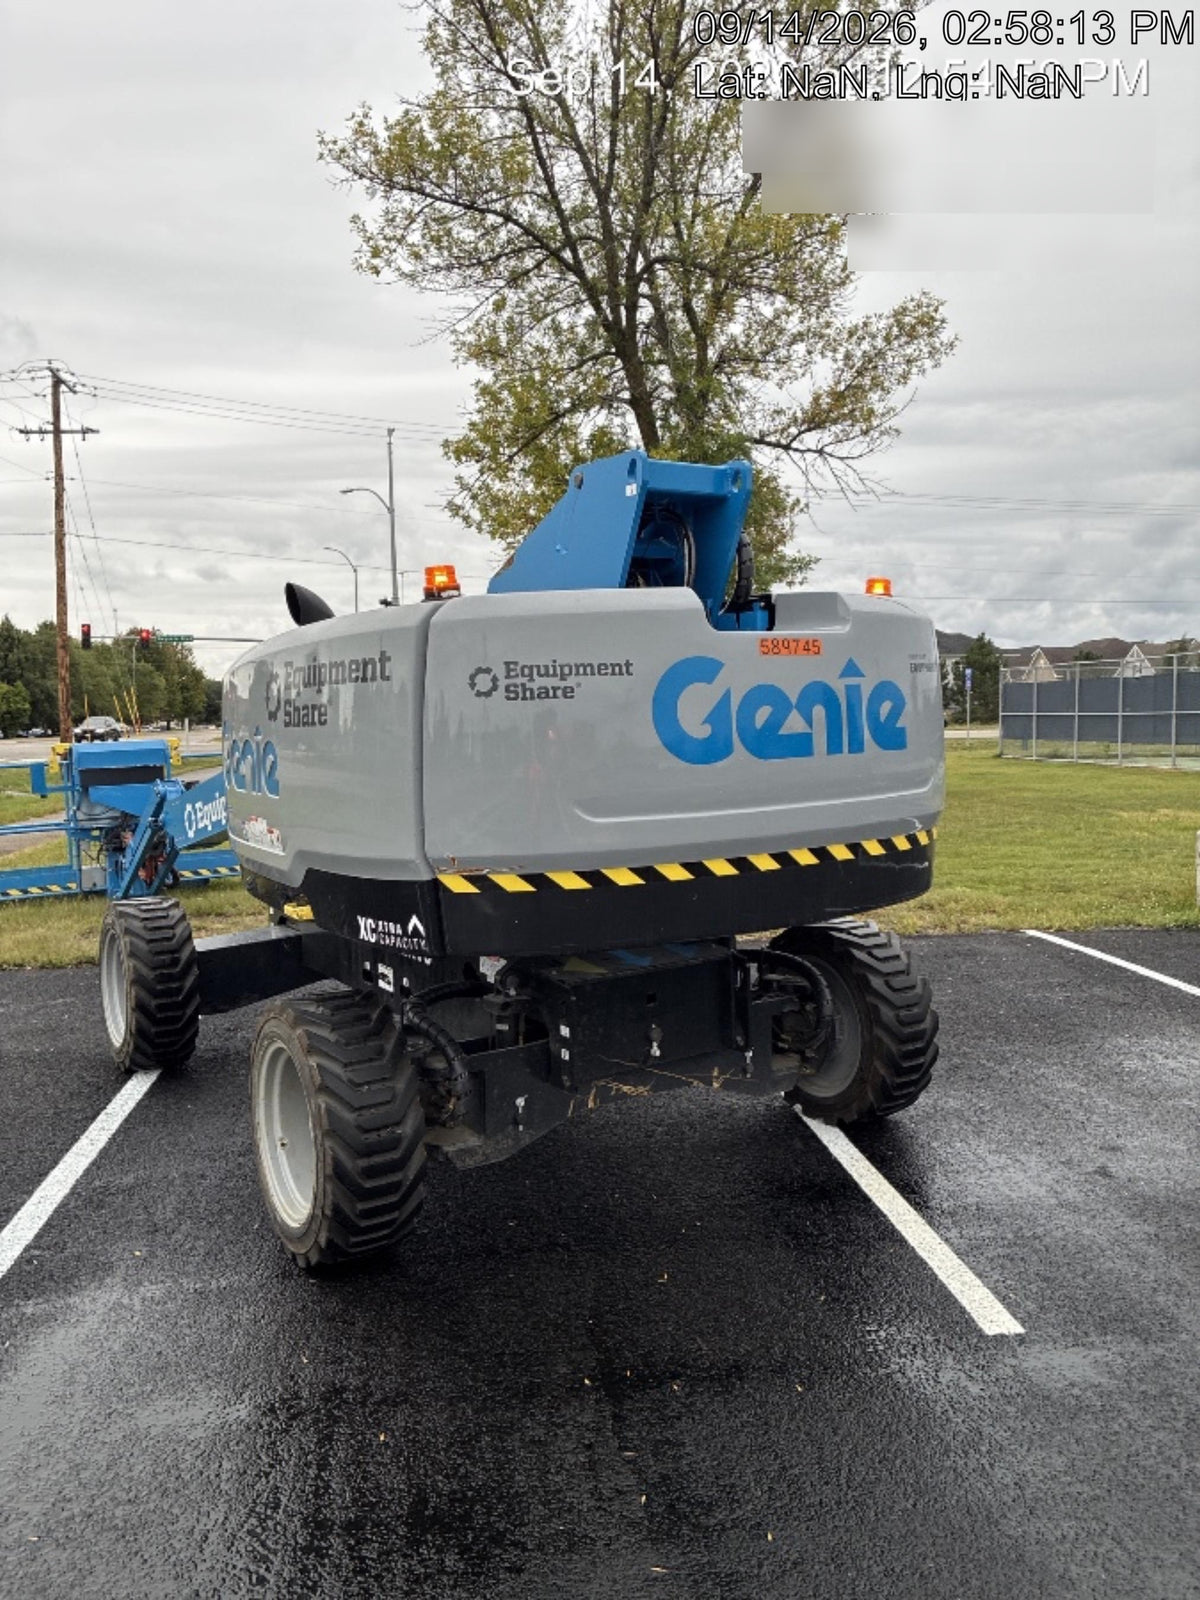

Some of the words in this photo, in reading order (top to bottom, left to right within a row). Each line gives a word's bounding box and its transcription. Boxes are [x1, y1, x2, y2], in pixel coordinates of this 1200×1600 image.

[760, 638, 821, 655] 589745
[283, 650, 392, 695] Equipment
[503, 659, 634, 682] Equipment
[283, 698, 328, 728] Share
[652, 655, 908, 765] Genie
[356, 915, 376, 943] XC
